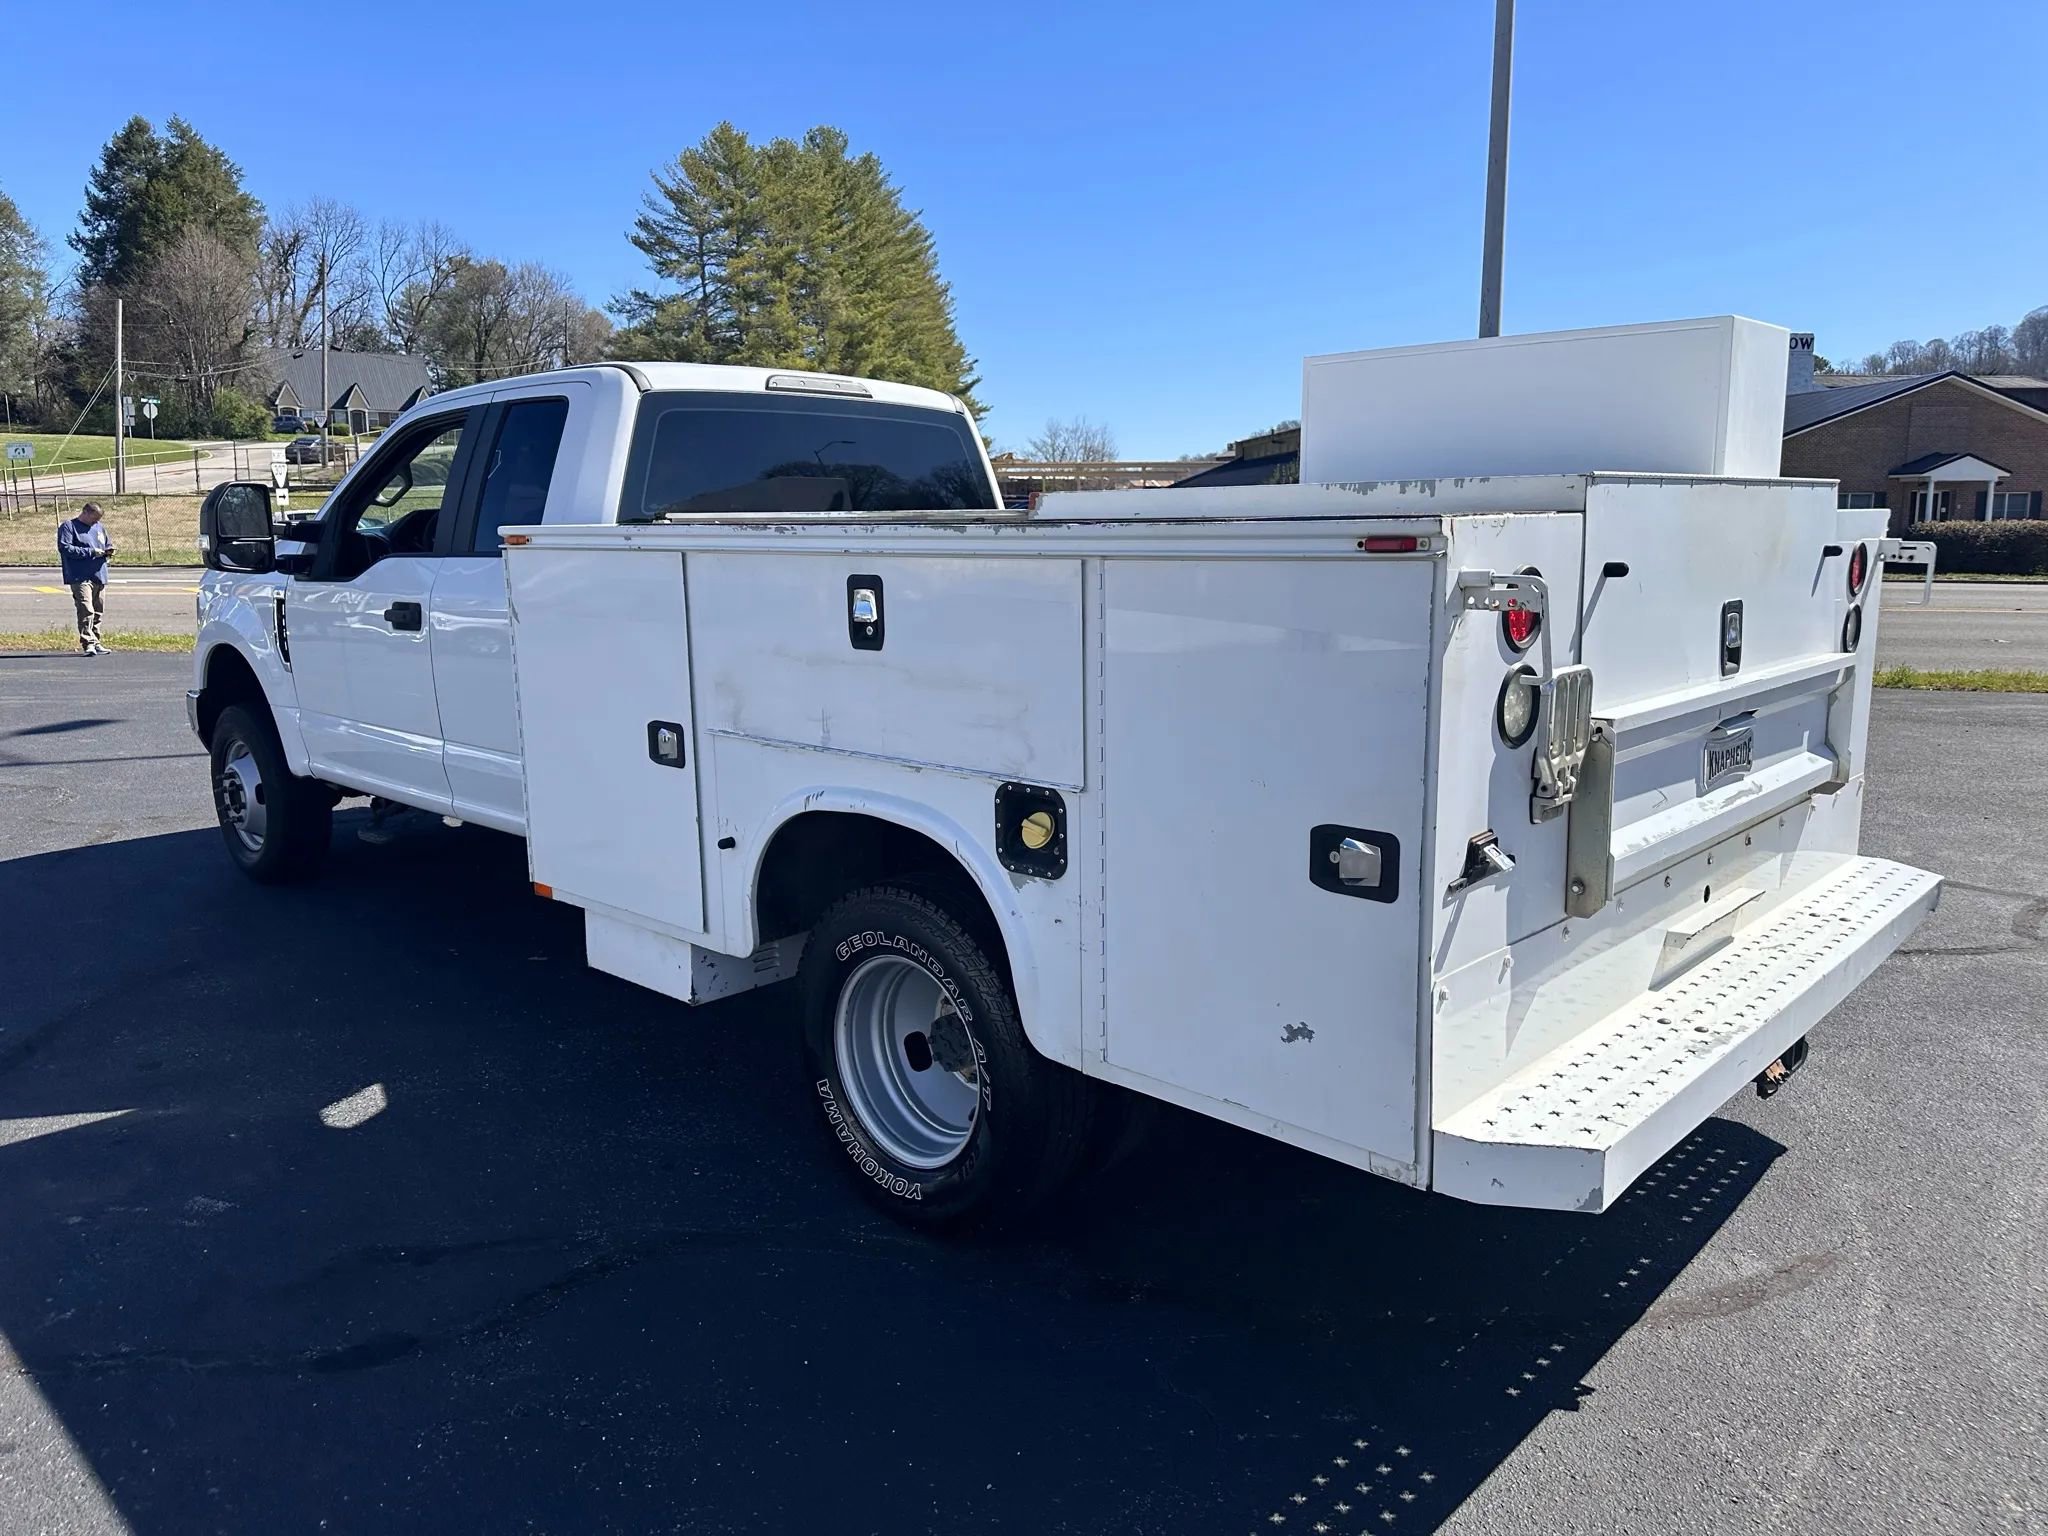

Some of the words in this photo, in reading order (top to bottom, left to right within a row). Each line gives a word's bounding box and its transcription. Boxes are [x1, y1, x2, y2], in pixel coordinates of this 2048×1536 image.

[1708, 736, 1752, 780] KNAPHEIDE
[835, 931, 974, 1022] GEOLANDAR
[816, 1078, 924, 1201] YOKOHAMA
